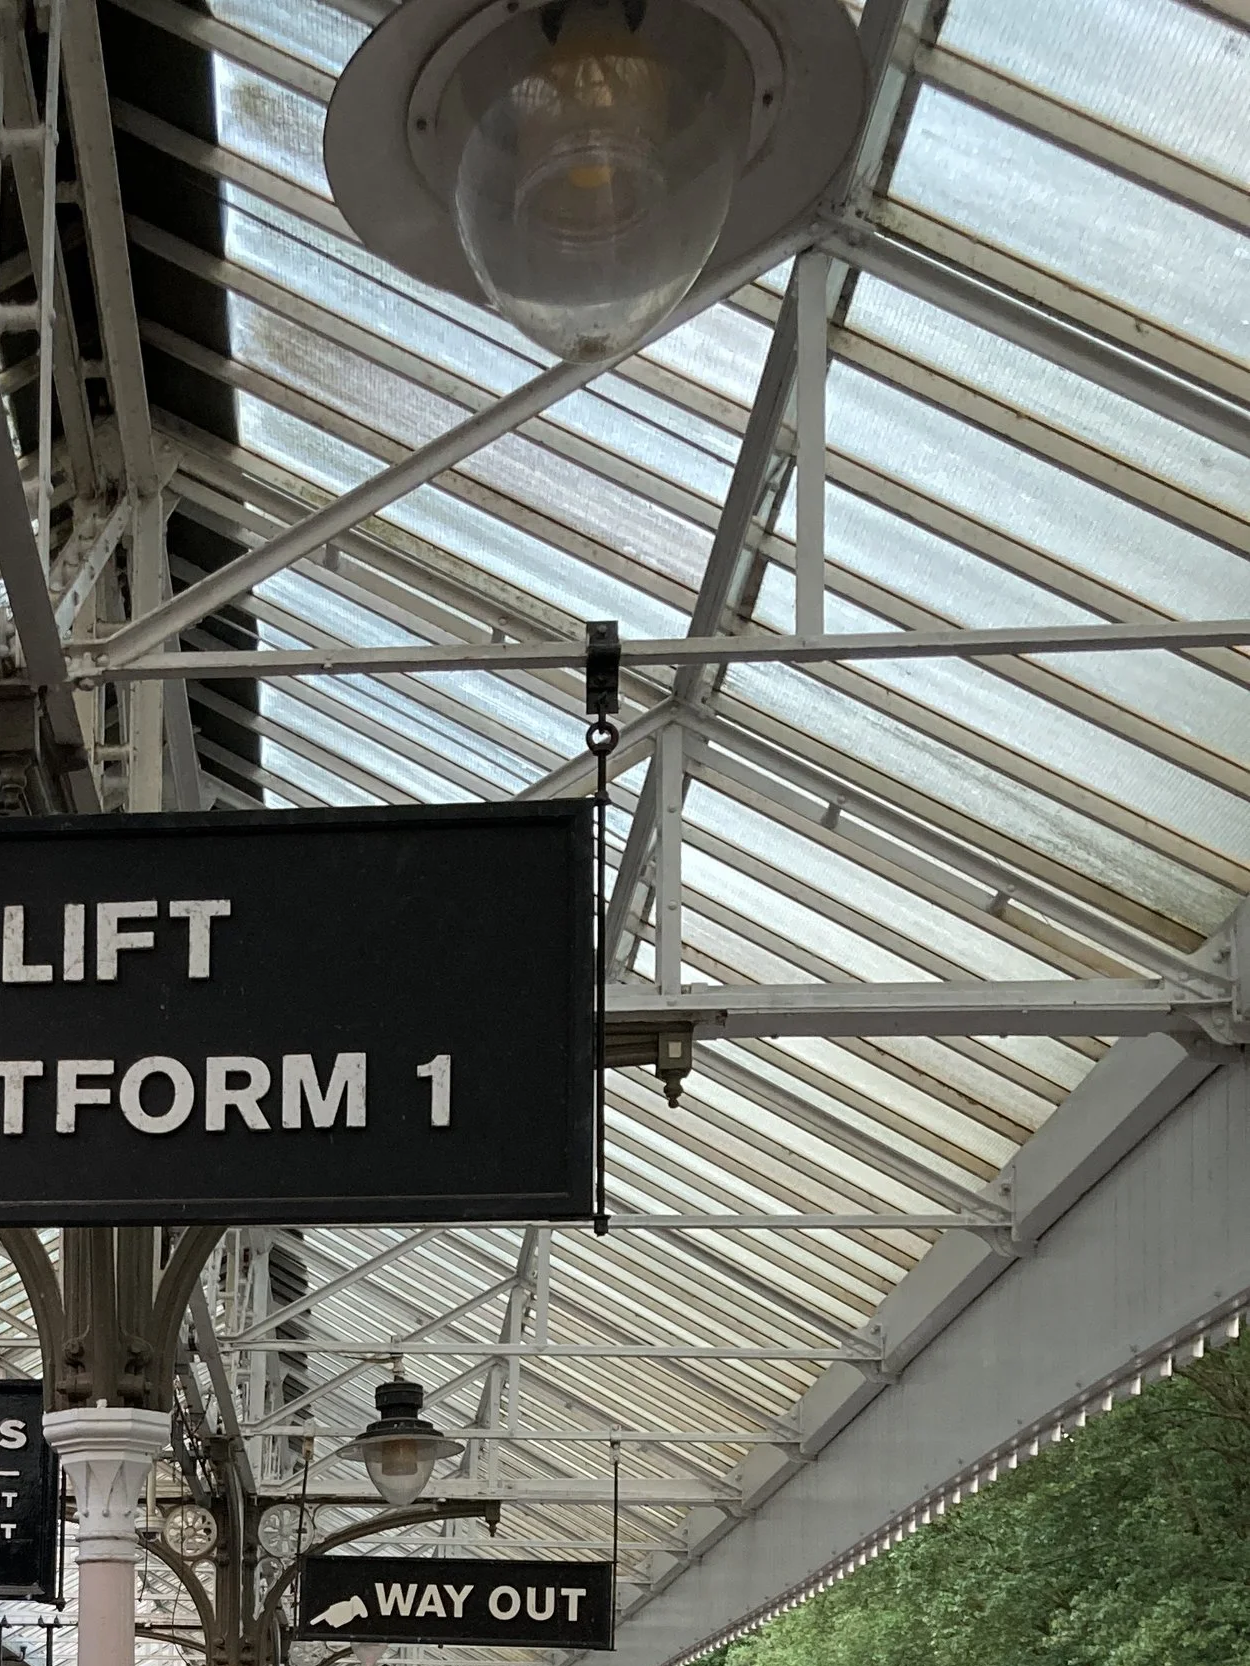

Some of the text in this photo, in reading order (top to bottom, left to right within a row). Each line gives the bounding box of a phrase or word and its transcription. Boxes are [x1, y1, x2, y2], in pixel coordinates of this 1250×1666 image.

[2, 899, 231, 984] LIFT
[416, 1054, 452, 1128] 1
[374, 1582, 587, 1622] WAY OUT
